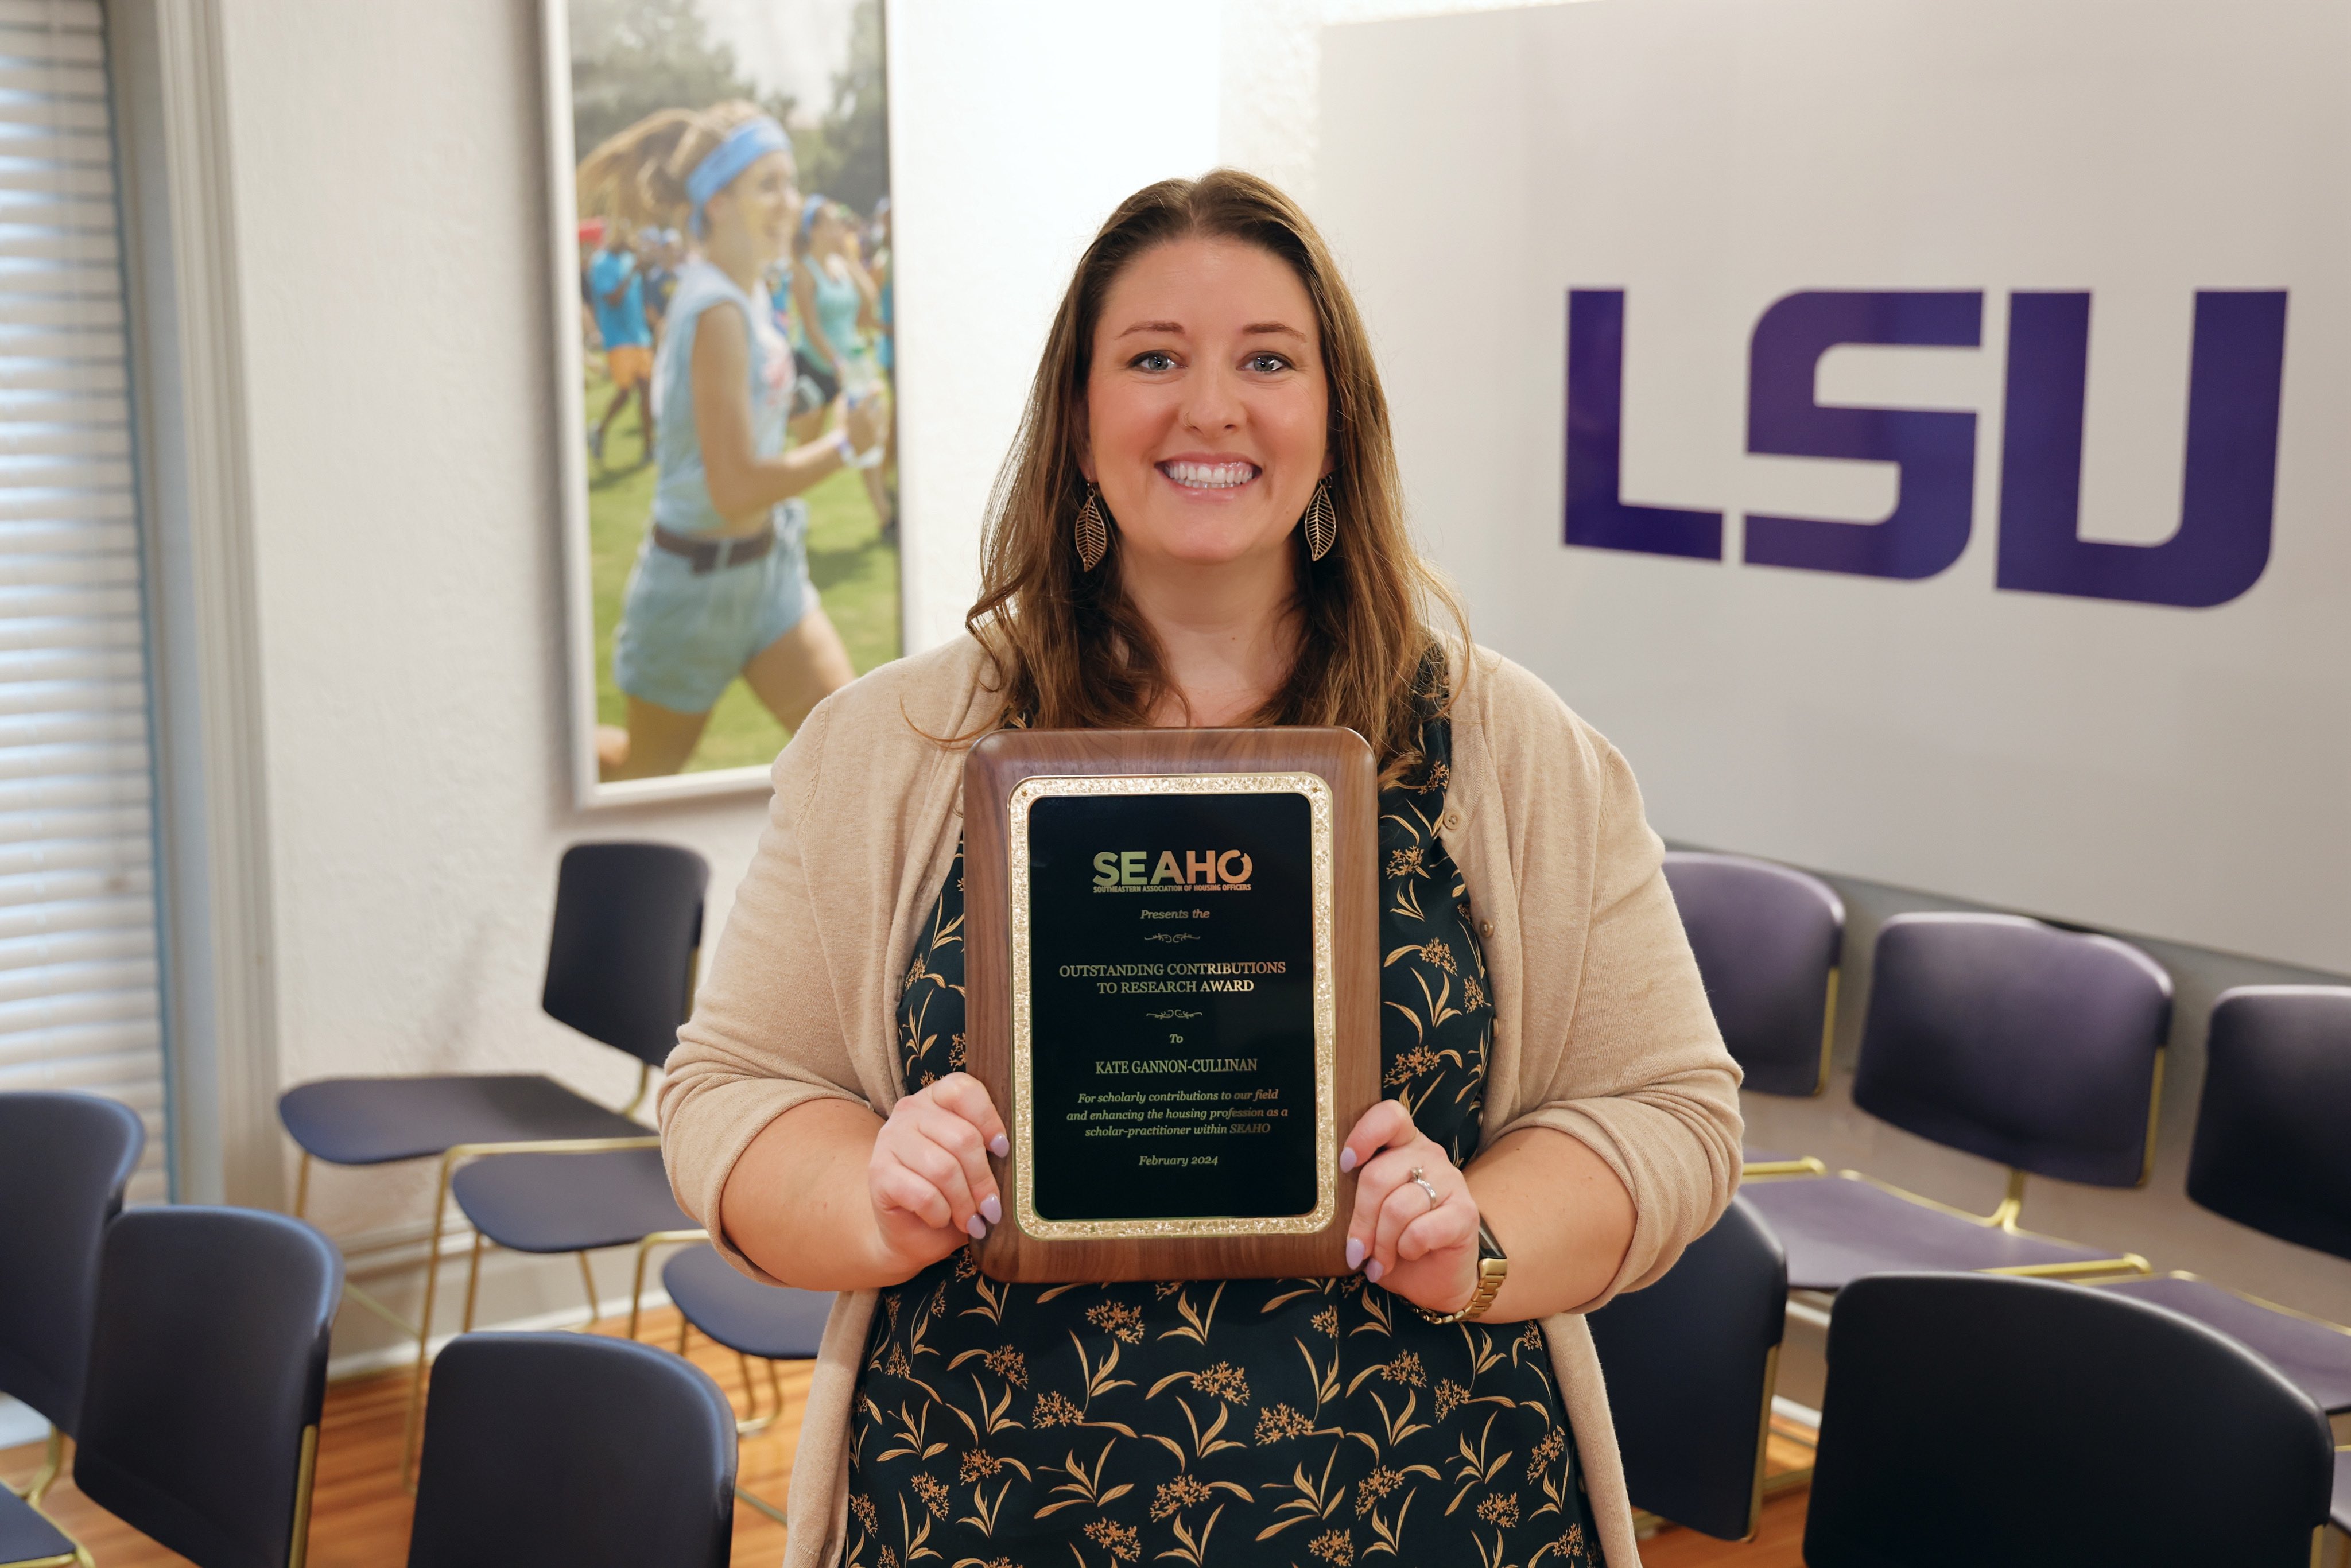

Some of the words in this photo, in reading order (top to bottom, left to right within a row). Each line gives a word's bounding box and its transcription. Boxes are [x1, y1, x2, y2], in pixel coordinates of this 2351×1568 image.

[1563, 290, 2288, 610] LSU
[1093, 850, 1252, 885] SEAHO
[1140, 910, 1188, 919] Presents
[1193, 909, 1210, 918] the
[1060, 964, 1164, 977] OUTSTANDING
[1167, 962, 1286, 975] CONTRIBUTIONS
[1097, 983, 1117, 993] TO
[1121, 981, 1196, 993] RESEARCH
[1201, 980, 1254, 991] AWARD
[1170, 1034, 1183, 1043] To
[1096, 1061, 1129, 1074] KATE
[1132, 1059, 1257, 1073] GANNON-CULLINAN
[1078, 1094, 1096, 1103] For
[1097, 1092, 1146, 1104] scholarly
[1149, 1091, 1218, 1101] contributions
[1221, 1092, 1231, 1100] to
[1253, 1089, 1278, 1101] field
[1066, 1110, 1087, 1120] and
[1090, 1110, 1144, 1121] enhancing
[1147, 1109, 1163, 1119] the
[1166, 1108, 1206, 1120] housing
[1209, 1108, 1263, 1120] profession
[1085, 1125, 1191, 1138] scholar-practitioner
[1194, 1124, 1227, 1134] within
[1229, 1123, 1270, 1133] SEAHO
[1139, 1155, 1188, 1166] February
[1191, 1156, 1218, 1165] 2024
